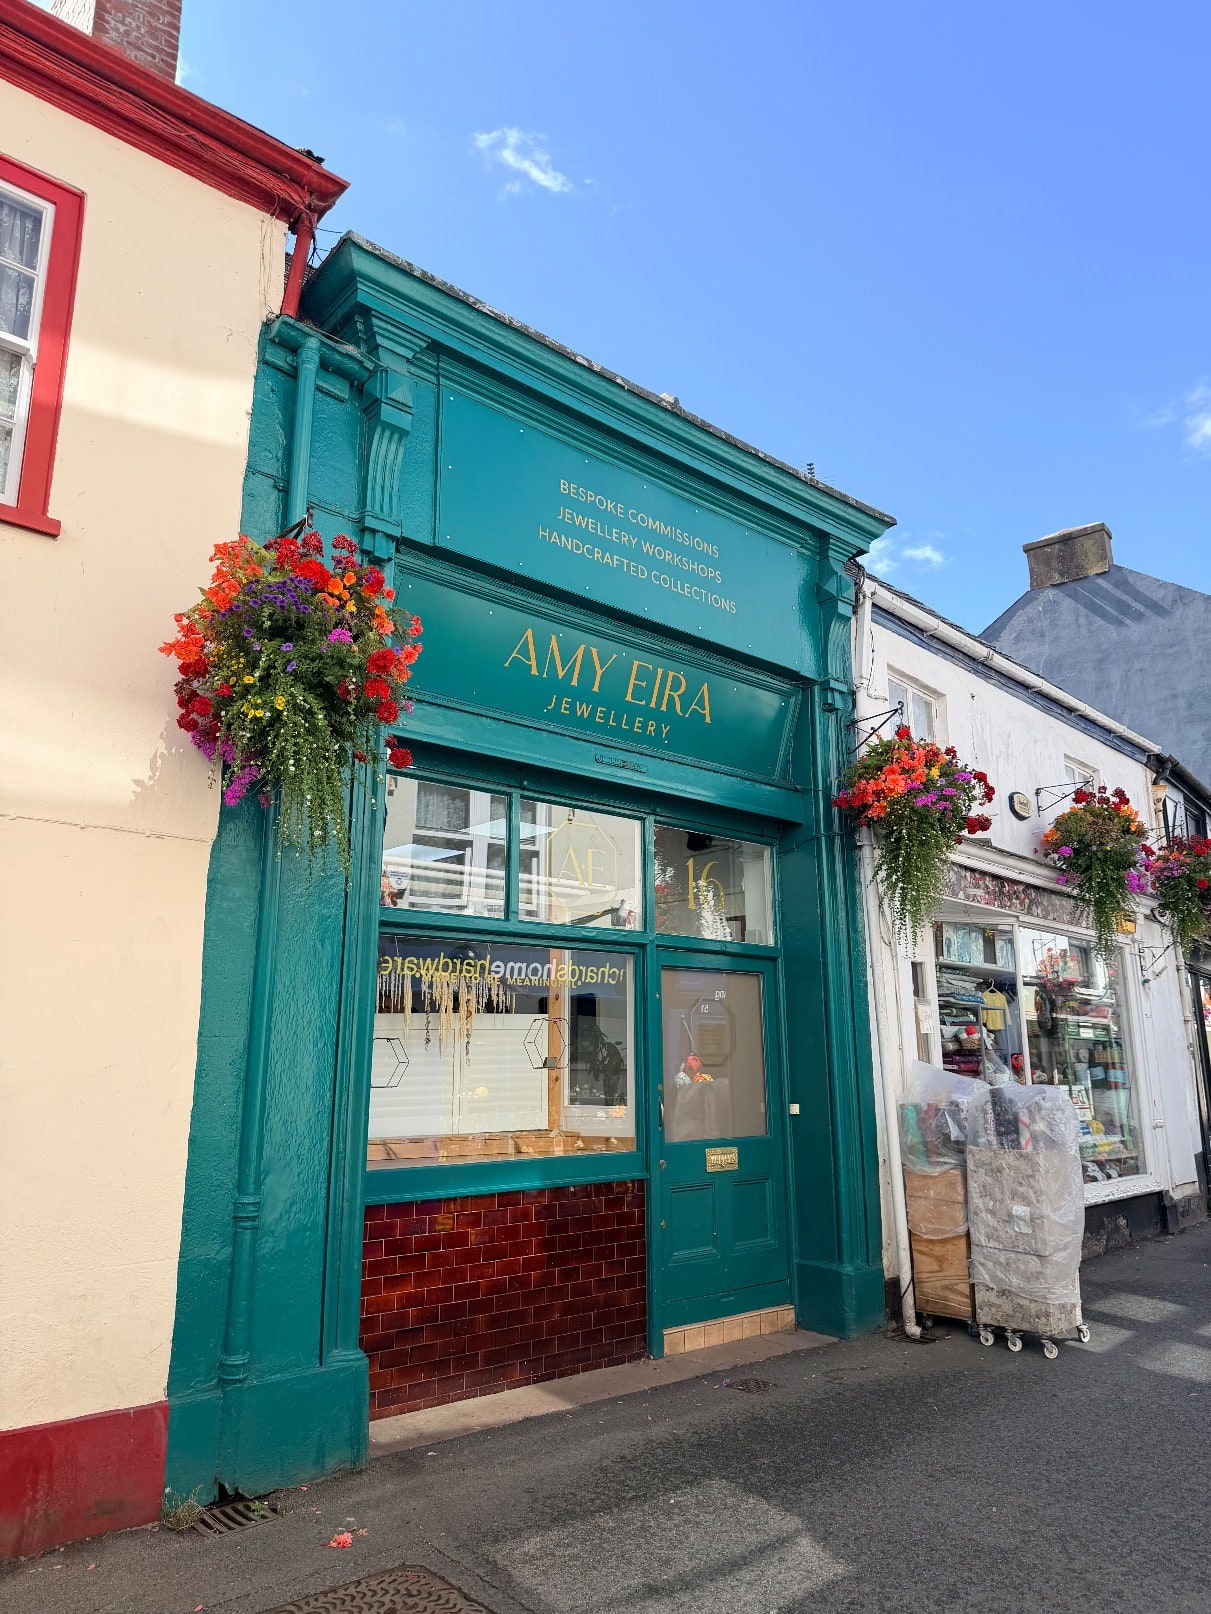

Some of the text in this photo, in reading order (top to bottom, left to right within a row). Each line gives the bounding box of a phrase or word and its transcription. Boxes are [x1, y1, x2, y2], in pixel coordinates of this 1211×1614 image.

[557, 506, 722, 584] JEWELLERY WORKSHOPS
[560, 479, 719, 558] BESPOKE COMMISSIONS
[538, 525, 736, 614] HANDCRAFTED COLLECTIONS
[504, 627, 712, 724] AMY EIRA
[547, 694, 671, 738] JEWELLERY
[685, 857, 725, 912] 16
[487, 975, 500, 985] BE
